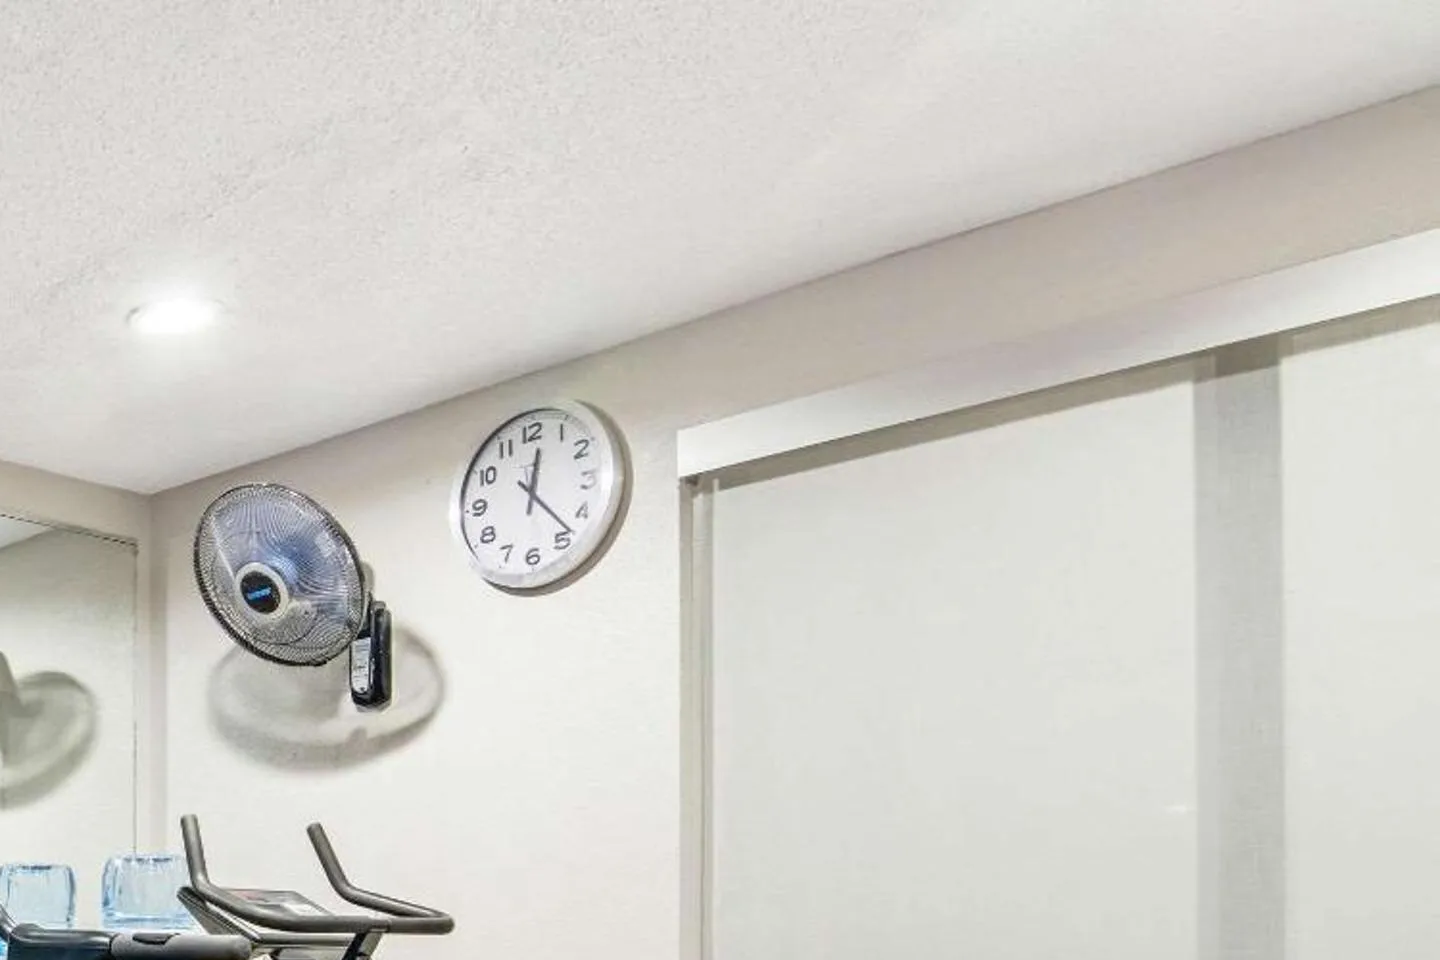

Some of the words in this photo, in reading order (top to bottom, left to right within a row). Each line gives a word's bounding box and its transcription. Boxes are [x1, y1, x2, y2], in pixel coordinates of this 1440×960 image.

[522, 422, 542, 444] 12
[499, 439, 513, 460] 11
[573, 439, 589, 460] 2
[479, 466, 497, 486] 10
[580, 469, 597, 490] 3
[472, 498, 488, 517] 9
[575, 501, 589, 519] 4
[480, 525, 496, 544] 8
[554, 530, 572, 550] 5
[500, 544, 514, 563] 7
[525, 548, 541, 566] 6
